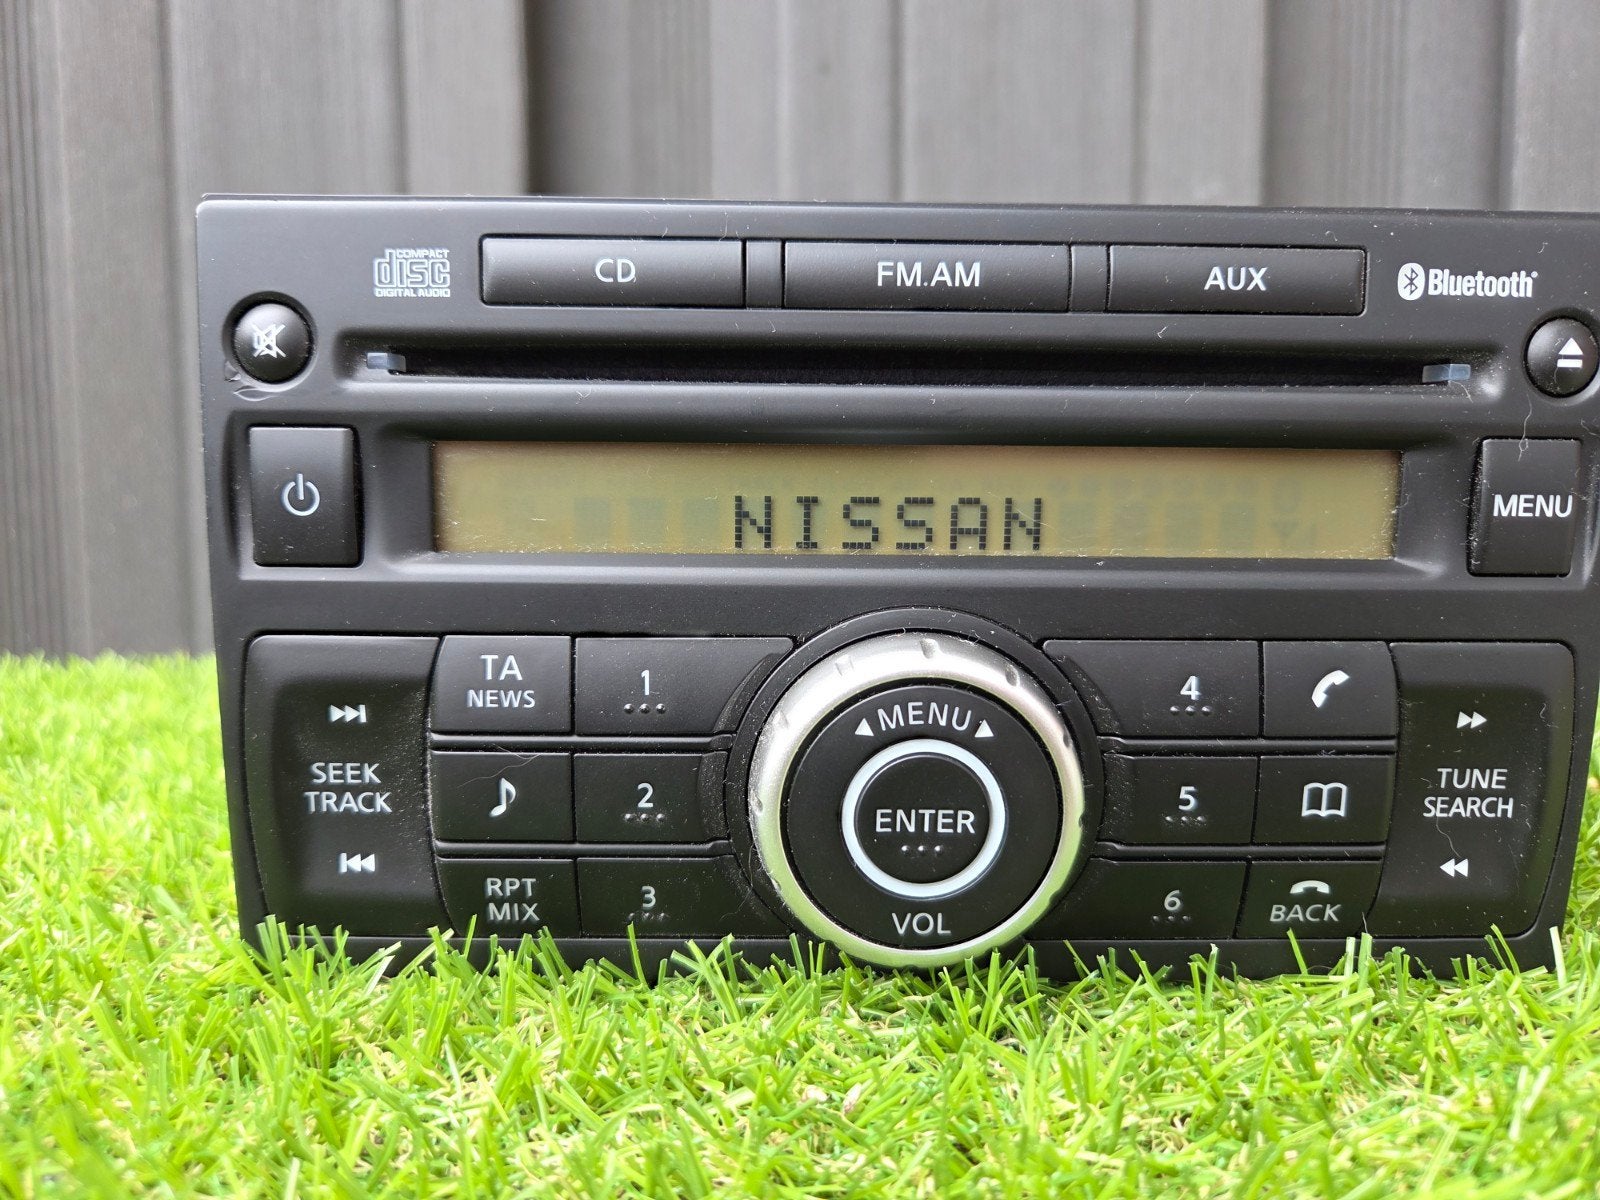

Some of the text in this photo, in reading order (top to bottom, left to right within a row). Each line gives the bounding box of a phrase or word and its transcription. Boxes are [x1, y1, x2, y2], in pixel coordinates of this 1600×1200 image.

[396, 248, 450, 259] COMPACT
[594, 258, 637, 284] CD
[877, 261, 981, 288] FM.AM
[1204, 266, 1268, 292] AUX
[375, 288, 450, 297] DIGITAL AUDIO
[1428, 269, 1533, 297] Bluetooth
[1493, 494, 1574, 518] MENU
[734, 495, 1042, 551] NISSAN
[480, 654, 523, 681] TA
[640, 669, 650, 696] 1
[1179, 675, 1200, 700] 4
[466, 689, 536, 709] NEWS
[877, 702, 972, 732] MENU
[310, 762, 382, 784] SEEK
[1437, 768, 1508, 789] TUNE
[304, 791, 393, 813] TRACK
[637, 783, 654, 808] 2
[1178, 785, 1196, 810] 5
[1423, 797, 1513, 818] SEARCH
[875, 809, 975, 834] ENTER
[485, 877, 537, 898] RPT
[642, 886, 656, 908] 3
[488, 902, 540, 922] MIX
[1164, 889, 1181, 912] 6
[891, 912, 951, 935] VOL
[1269, 904, 1339, 922] BACK
